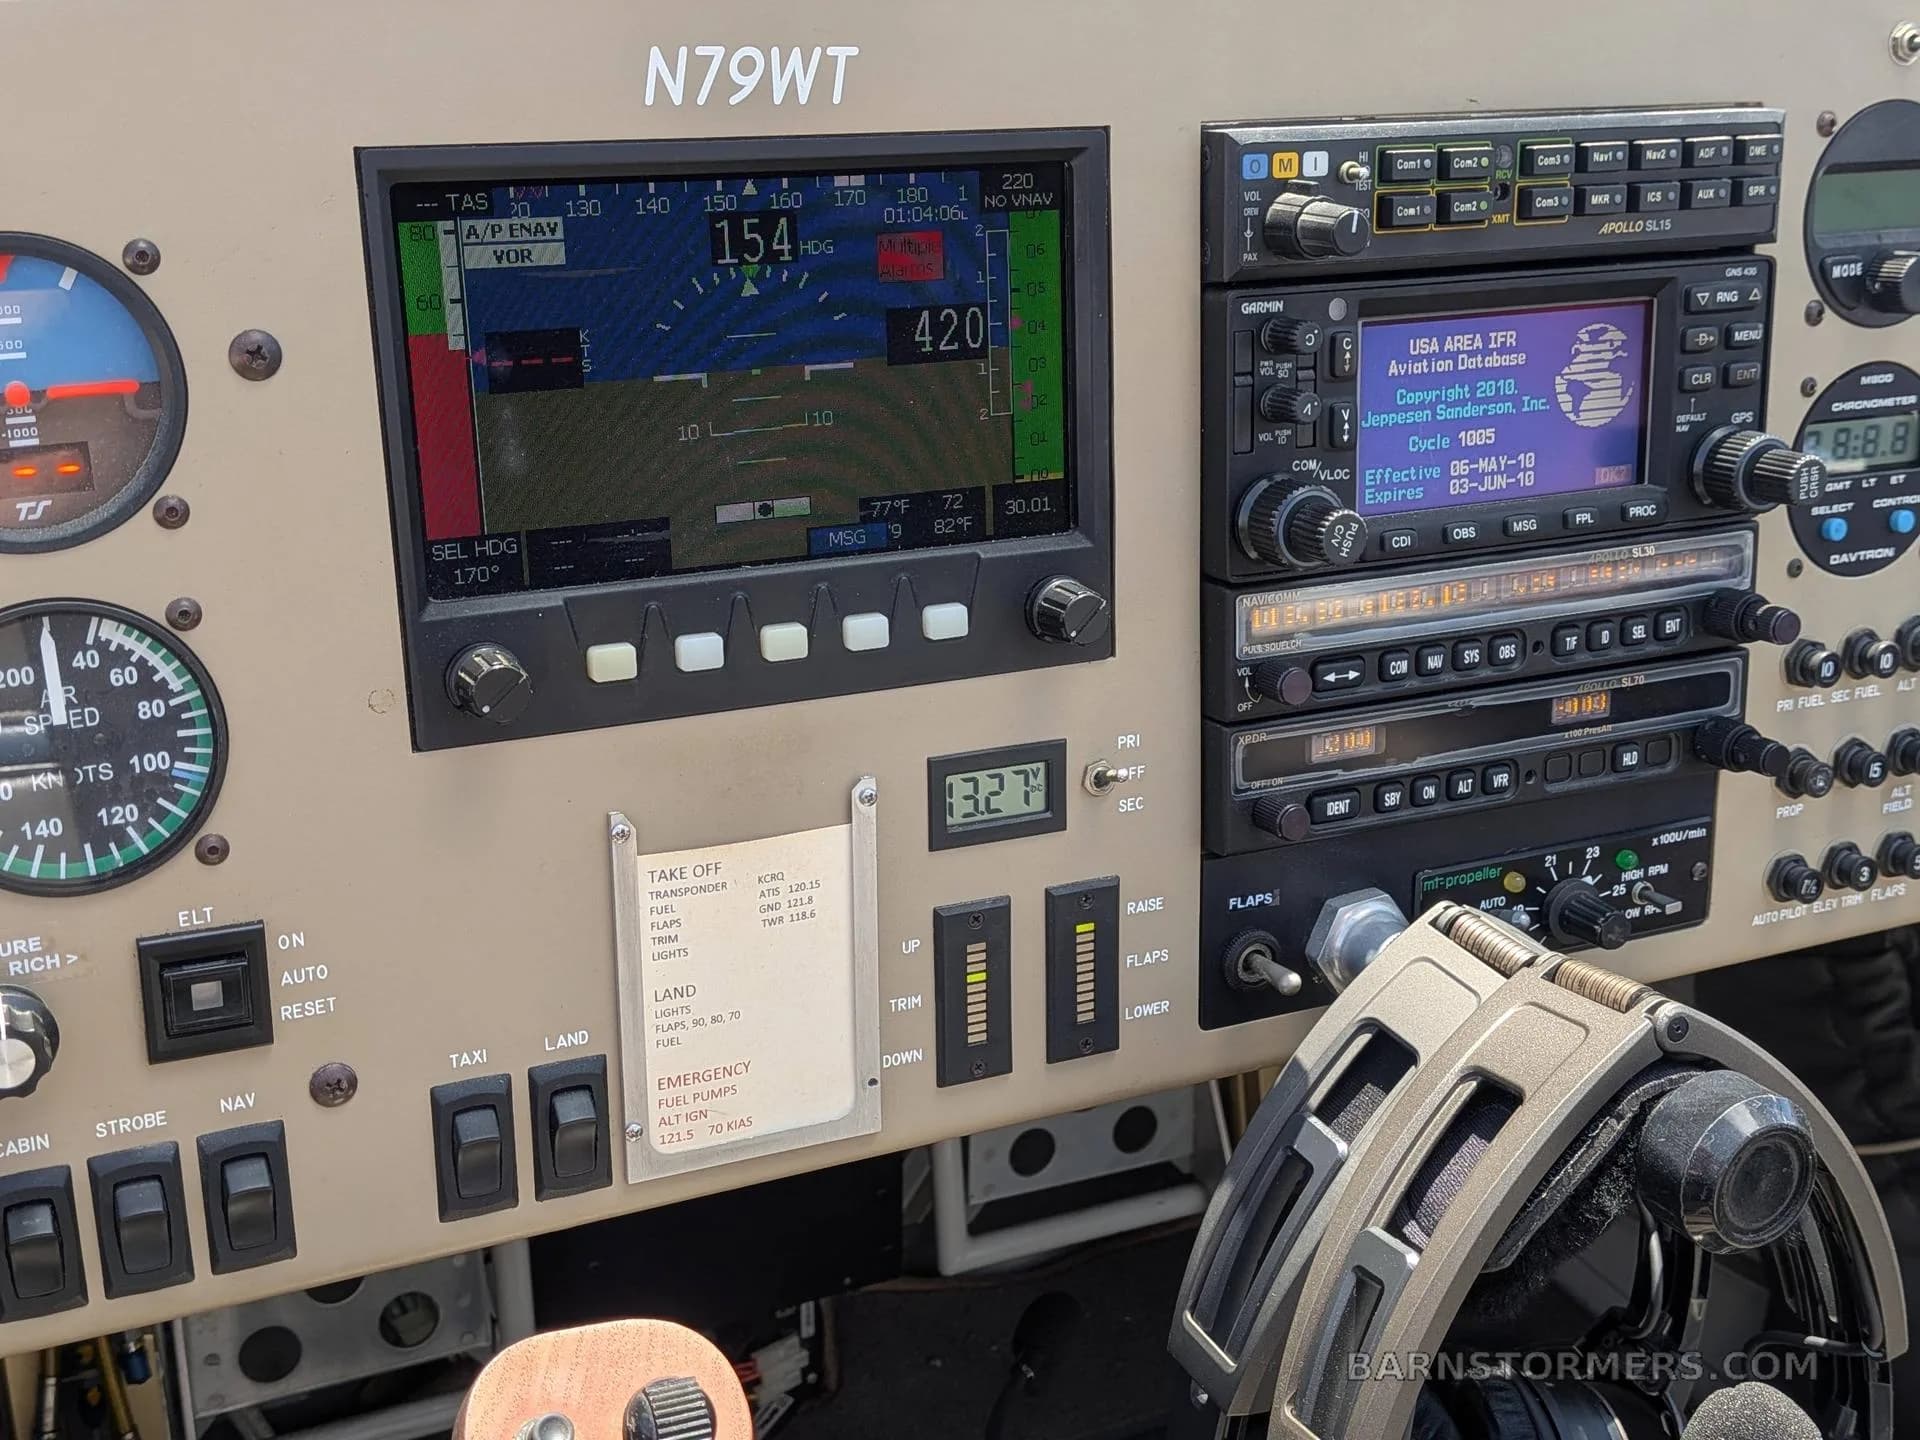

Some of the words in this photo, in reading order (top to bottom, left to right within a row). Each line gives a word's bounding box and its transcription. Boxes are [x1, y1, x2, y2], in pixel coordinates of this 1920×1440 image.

[645, 46, 859, 105] N79WT
[1359, 152, 1368, 162] HI
[1593, 151, 1612, 162] Nav1
[1646, 150, 1666, 160] Nav2
[1699, 148, 1715, 158] ADF
[1750, 144, 1766, 156] DME
[1397, 159, 1420, 170] Com1
[1454, 157, 1478, 167] Com2
[1538, 154, 1560, 166] Com3
[1002, 174, 1033, 189] 220
[1496, 170, 1512, 180] RCV
[1355, 180, 1372, 191] TEST
[1748, 186, 1765, 196] SPR
[770, 192, 802, 208] 160
[834, 190, 866, 206] 170
[897, 188, 928, 203] 180
[985, 195, 1006, 208] NO
[1012, 193, 1052, 206] VNAV
[1244, 192, 1261, 201] VOL
[1591, 194, 1610, 204] MKR
[1647, 191, 1661, 201] ICS
[1698, 189, 1714, 199] AUX
[446, 193, 488, 211] TAS
[566, 200, 600, 217] 130
[636, 197, 670, 214] 140
[704, 195, 737, 211] 150
[1454, 201, 1477, 211] Com2
[1536, 197, 1559, 208] Com3
[1397, 206, 1420, 217] Com1
[1492, 214, 1510, 223] XMT
[1599, 221, 1643, 235] APOLLO
[1646, 219, 1671, 231] SL15
[716, 217, 792, 264] 154
[801, 241, 833, 254] HDG
[492, 249, 533, 264] VOR
[1243, 252, 1257, 262] PAX
[1832, 263, 1863, 279] MODE
[1717, 292, 1738, 303] RNG
[1242, 300, 1283, 314] GARMIN
[915, 307, 984, 351] 420
[1734, 329, 1762, 341] MENU
[1410, 339, 1439, 355] USA
[1444, 335, 1483, 352] AREA
[1489, 331, 1516, 348] IFR
[1260, 367, 1274, 376] VOL
[1389, 358, 1453, 376] Aviation
[1458, 353, 1526, 370] Database
[1692, 373, 1711, 385] CLR
[1737, 368, 1757, 380] ENT
[1397, 384, 1470, 405] Copyright
[1832, 396, 1917, 411] CHRONOMETER
[1362, 405, 1431, 428] Jeppesen
[1436, 402, 1516, 420] Sanderson,
[1522, 396, 1550, 411] Inc.
[1677, 413, 1706, 423] DEFAULT
[1731, 412, 1753, 424] GPS
[1259, 433, 1273, 441] VOL
[1409, 434, 1450, 452] Cycle
[1458, 428, 1495, 447] 1005
[1365, 465, 1440, 486] Effective
[1450, 453, 1535, 476] 06-MAY-10
[1825, 481, 1852, 492] GMT
[1862, 478, 1877, 488] LT
[1890, 475, 1906, 484] ET
[1365, 485, 1423, 504] Expires
[1450, 471, 1535, 494] 03-JUN-10
[1630, 505, 1656, 518] PROC
[1811, 503, 1854, 515] SELECT
[1513, 520, 1536, 532] MSG
[1576, 513, 1594, 525] FPL
[829, 529, 866, 546] MSG
[1454, 528, 1475, 539] OBS
[1392, 536, 1411, 547] CDI
[432, 544, 468, 561] SEL
[476, 538, 517, 556] HDG
[1632, 546, 1655, 558] SL30
[1830, 547, 1894, 564] DAVTRON
[1666, 619, 1681, 633] ENT
[72, 650, 99, 669] 40
[1464, 649, 1479, 664] SYS
[1500, 645, 1515, 659] OBS
[1390, 660, 1407, 675] COM
[1428, 655, 1443, 669] NAV
[110, 666, 137, 686] 60
[1237, 667, 1252, 676] VOL
[1621, 675, 1644, 688] SL70
[1831, 690, 1849, 703] SEC
[1855, 685, 1881, 698] FUEL
[138, 699, 165, 719] 80
[1238, 703, 1252, 712] OFF
[1777, 700, 1793, 712] PRI
[1798, 695, 1824, 708] FUEL
[1118, 734, 1140, 748] PRI
[130, 751, 170, 773] 100
[1623, 751, 1637, 765] HLD
[1457, 779, 1473, 794] ALT
[1493, 772, 1509, 788] VFR
[1385, 792, 1401, 807] SBY
[1423, 786, 1435, 799] ON
[1119, 797, 1144, 813] SEC
[1327, 800, 1350, 815] IDENT
[1776, 803, 1804, 818] PROP
[1883, 799, 1912, 813] FIELD
[98, 804, 138, 826] 120
[21, 818, 63, 840] 140
[1586, 847, 1599, 858] 23
[1545, 855, 1556, 866] 21
[648, 867, 688, 884] TAKE
[693, 862, 722, 878] OFF
[758, 872, 784, 885] KCRQ
[1423, 866, 1502, 891] mt-propeller
[1621, 869, 1644, 882] HIGH
[1648, 864, 1668, 876] RPM
[648, 881, 727, 901] TRANSPONDER
[759, 887, 780, 899] ATIS
[789, 880, 820, 893] 120.15
[1612, 884, 1626, 896] 25
[1871, 884, 1905, 901] FLAPS
[759, 902, 781, 914] GND
[787, 896, 813, 909] 121.8
[1127, 897, 1164, 915] RAISE
[1229, 892, 1273, 910] FLAPS
[1480, 897, 1505, 909] AUTO
[179, 907, 214, 926] ELT
[650, 905, 675, 916] FUEL
[1752, 907, 1778, 926] AUTO
[1779, 904, 1807, 919] PILOT
[650, 919, 681, 931] FLAPS
[761, 916, 784, 928] TWR
[790, 910, 816, 923] 118.6
[278, 932, 305, 949] ON
[651, 934, 678, 946] TRIM
[902, 940, 920, 954] UP
[652, 948, 688, 961] LIGHTS
[1127, 950, 1168, 968] FLAPS
[9, 954, 60, 976] RICH
[281, 965, 328, 986] AUTO
[654, 984, 696, 1002] LAND
[281, 998, 336, 1021] RESET
[890, 995, 922, 1012] TRIM
[1125, 1001, 1169, 1020] LOWER
[655, 1005, 691, 1019] LIGHTS
[656, 1021, 689, 1034] FLAPS,
[692, 1018, 707, 1028] 90,
[711, 1014, 725, 1024] 80,
[728, 1011, 740, 1021] 70
[544, 1030, 589, 1051] LAND
[656, 1036, 682, 1048] FUEL
[449, 1049, 488, 1069] TAXI
[883, 1049, 922, 1068] DOWN
[658, 1060, 751, 1091] EMERGENCY
[220, 1093, 255, 1113] NAV
[658, 1096, 689, 1110] FUEL
[693, 1085, 737, 1103] PUMPS
[96, 1111, 167, 1138] STROBE
[658, 1114, 681, 1127] ALT
[686, 1109, 708, 1123] IGN
[659, 1129, 694, 1145] 121.5
[708, 1124, 723, 1135] 70
[727, 1116, 753, 1131] KIAS
